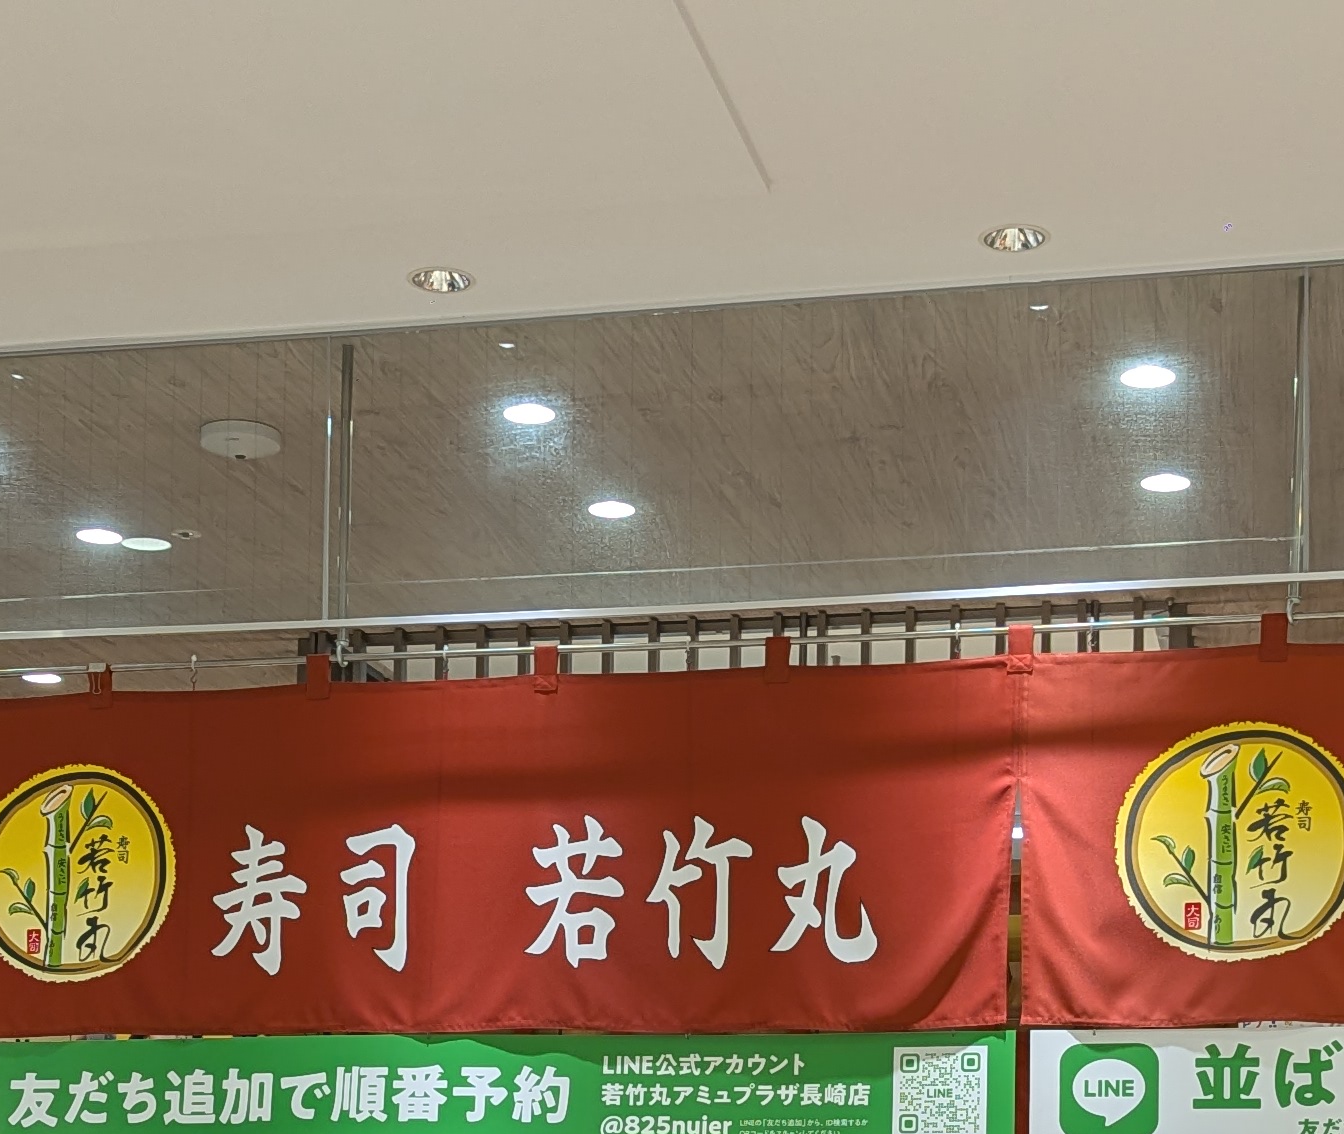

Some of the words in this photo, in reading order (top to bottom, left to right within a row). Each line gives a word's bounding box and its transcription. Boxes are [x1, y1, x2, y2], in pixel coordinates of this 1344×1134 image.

[210, 823, 415, 976] 寿司
[524, 814, 879, 970] 若竹丸
[602, 1053, 806, 1077] LINE公式アカウント
[7, 1063, 571, 1129] 友だち追加で順番予約
[600, 1082, 871, 1107] 若竹丸アミュプラザ長崎店
[926, 1087, 954, 1099] LINE
[1082, 1078, 1136, 1100] LINE
